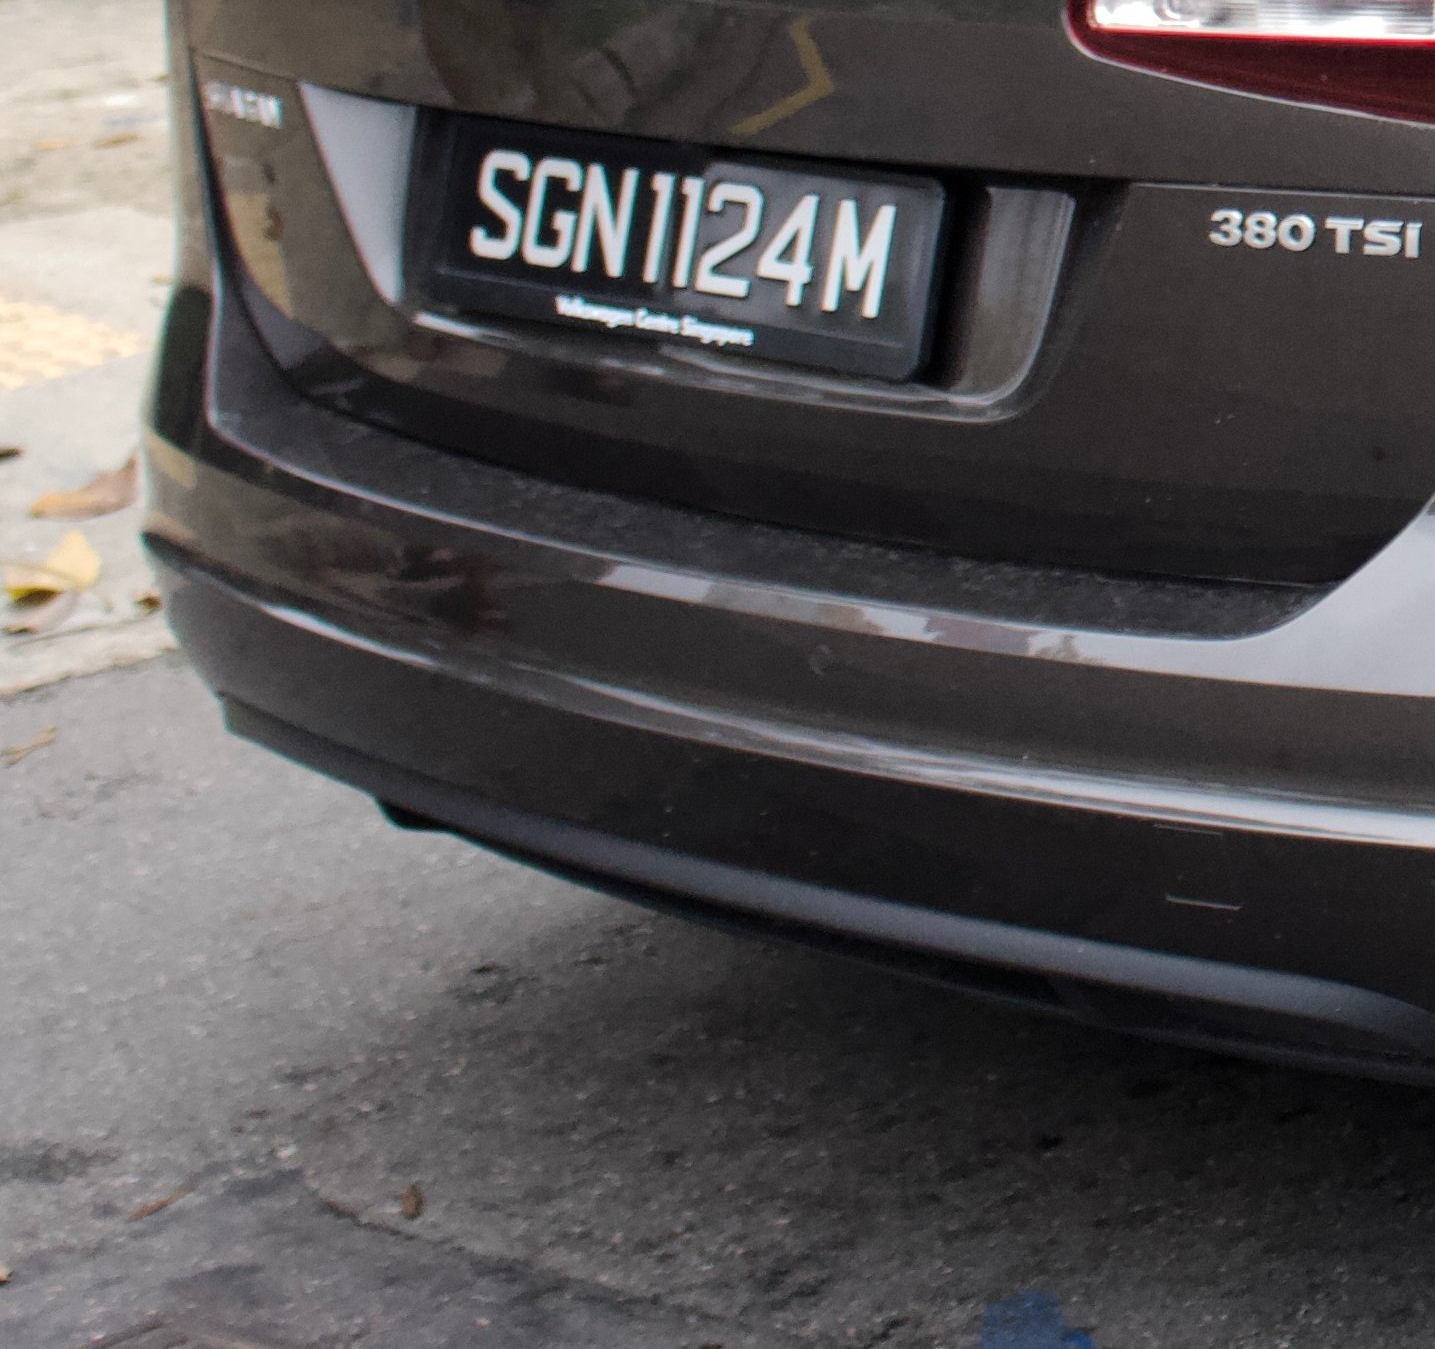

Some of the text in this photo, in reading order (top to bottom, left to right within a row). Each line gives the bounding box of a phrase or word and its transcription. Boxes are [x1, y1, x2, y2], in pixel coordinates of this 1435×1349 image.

[469, 148, 898, 320] SGN1124M
[1208, 207, 1423, 259] 380 TSI
